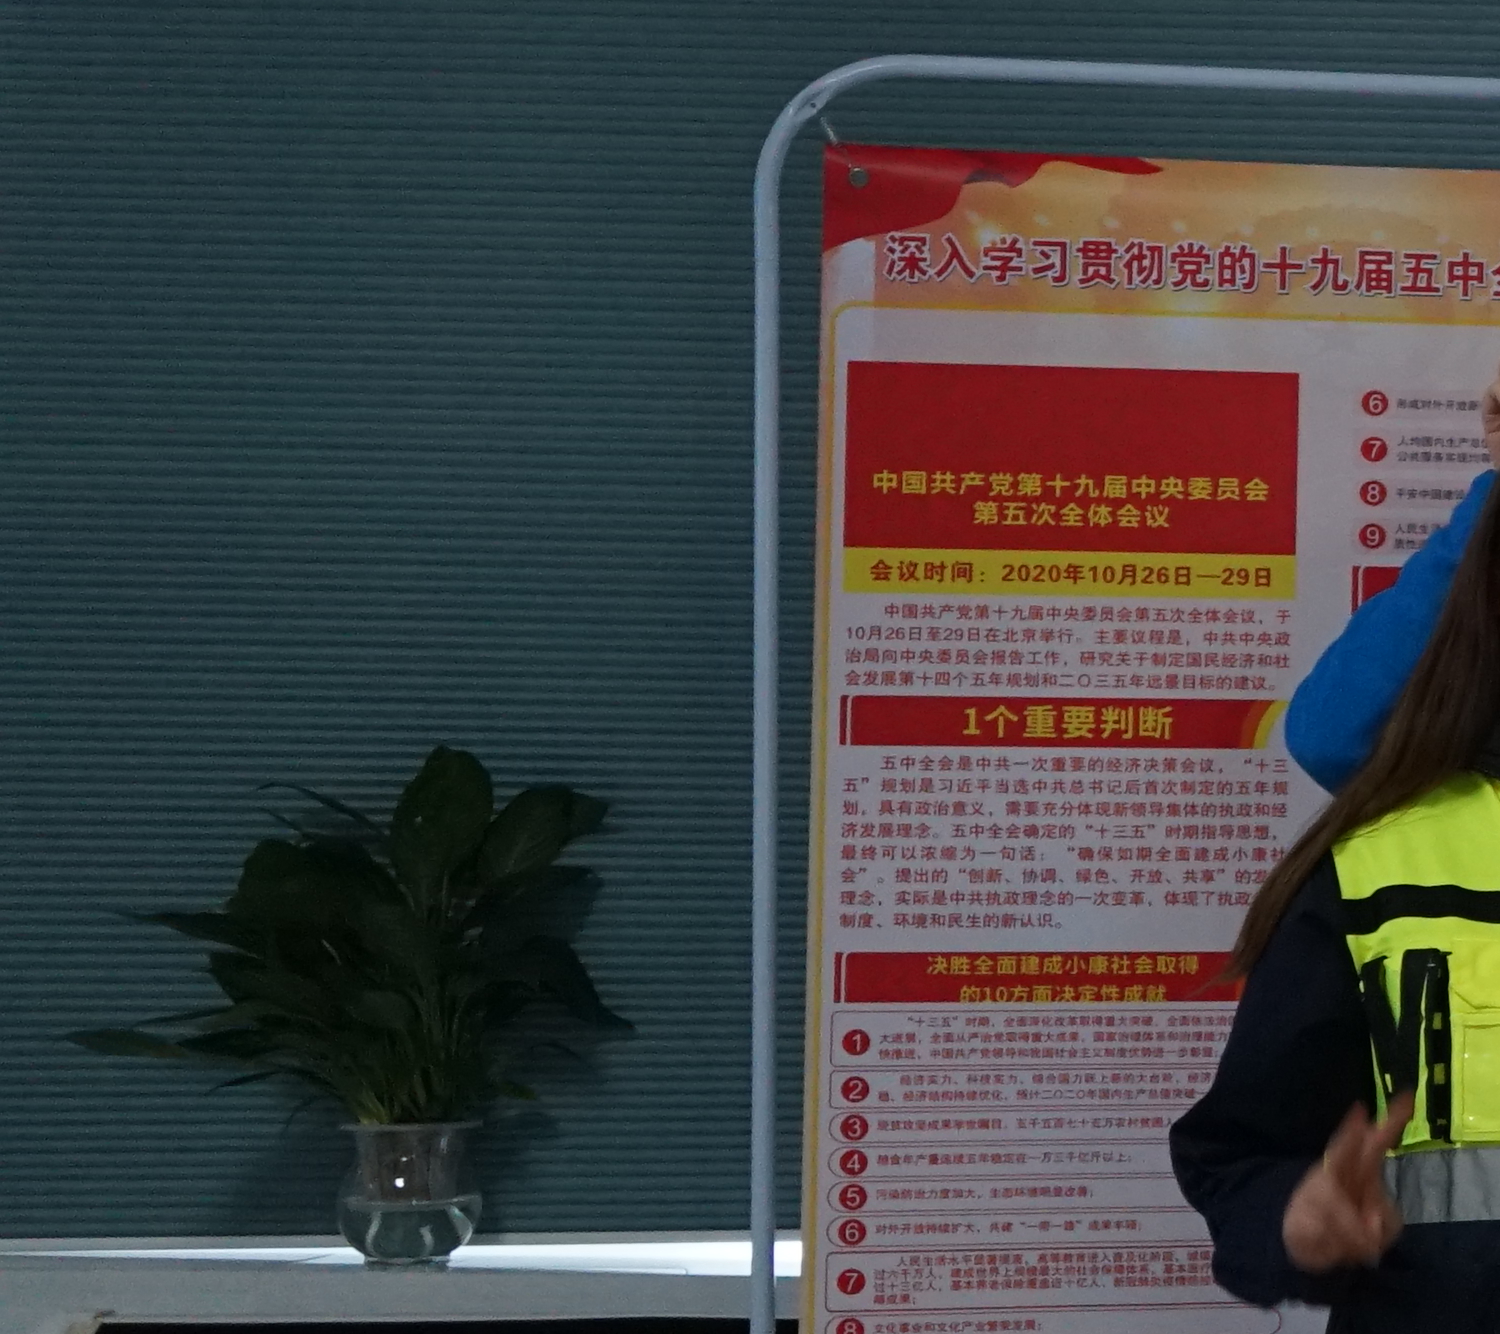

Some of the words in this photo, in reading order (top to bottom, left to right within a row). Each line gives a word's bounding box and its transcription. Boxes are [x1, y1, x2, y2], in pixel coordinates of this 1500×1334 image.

[872, 470, 1270, 502] 中国共产党第十九届中央委员会
[973, 501, 1170, 528] 第五次全体会议
[961, 704, 1174, 741] 1个重要判断
[927, 954, 1199, 977] 决胜全面建成小康社会取得
[959, 984, 1168, 1003] 的10方面决定性成就
